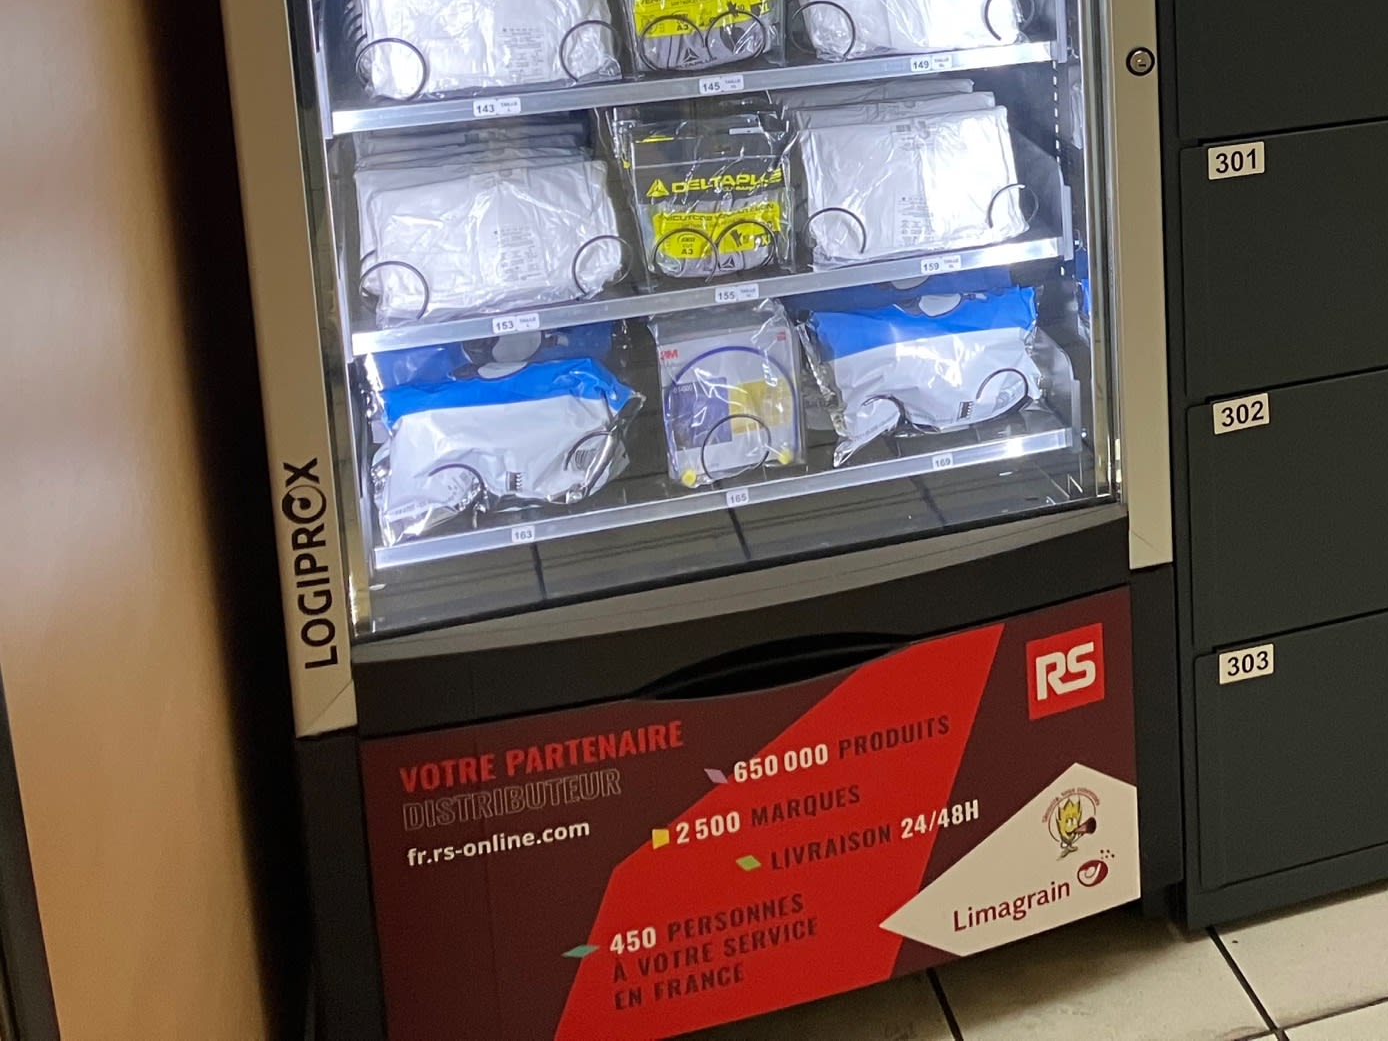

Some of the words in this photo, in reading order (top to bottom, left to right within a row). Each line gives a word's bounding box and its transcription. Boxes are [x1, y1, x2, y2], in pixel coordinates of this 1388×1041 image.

[912, 61, 929, 70] 149
[702, 82, 720, 92] 145
[476, 104, 494, 114] 143
[1215, 148, 1258, 174] 301
[923, 262, 940, 271] 159
[718, 291, 735, 300] 155
[496, 320, 514, 330] 153
[1221, 401, 1265, 427] 302
[935, 457, 951, 467] 169
[730, 494, 747, 503] 165
[514, 530, 532, 540] 163
[281, 457, 338, 670] LOGIPROX
[1035, 641, 1096, 701] RS
[1227, 650, 1270, 677] 303
[400, 754, 496, 793] VOTRE
[506, 720, 684, 777] PARTENAIRE
[733, 755, 778, 783] 650
[784, 744, 829, 771] 000
[838, 715, 950, 760] PRODUITS
[403, 768, 621, 831] DISTRIBUTEUR
[676, 822, 690, 845] 2
[695, 811, 741, 840] 500
[751, 785, 860, 827] MARQUES
[407, 821, 590, 867] fr.rs-online.com
[770, 824, 892, 871] LIVRAISON
[900, 799, 980, 840] 24/48H
[610, 926, 656, 954] 450
[667, 893, 805, 943] PERSONNES
[953, 880, 1071, 932] Limagrain
[612, 956, 626, 984] À
[638, 943, 714, 977] VOTRE
[724, 917, 818, 958] SERVICE
[614, 987, 642, 1011] EN
[653, 962, 745, 1002] FRANCE
